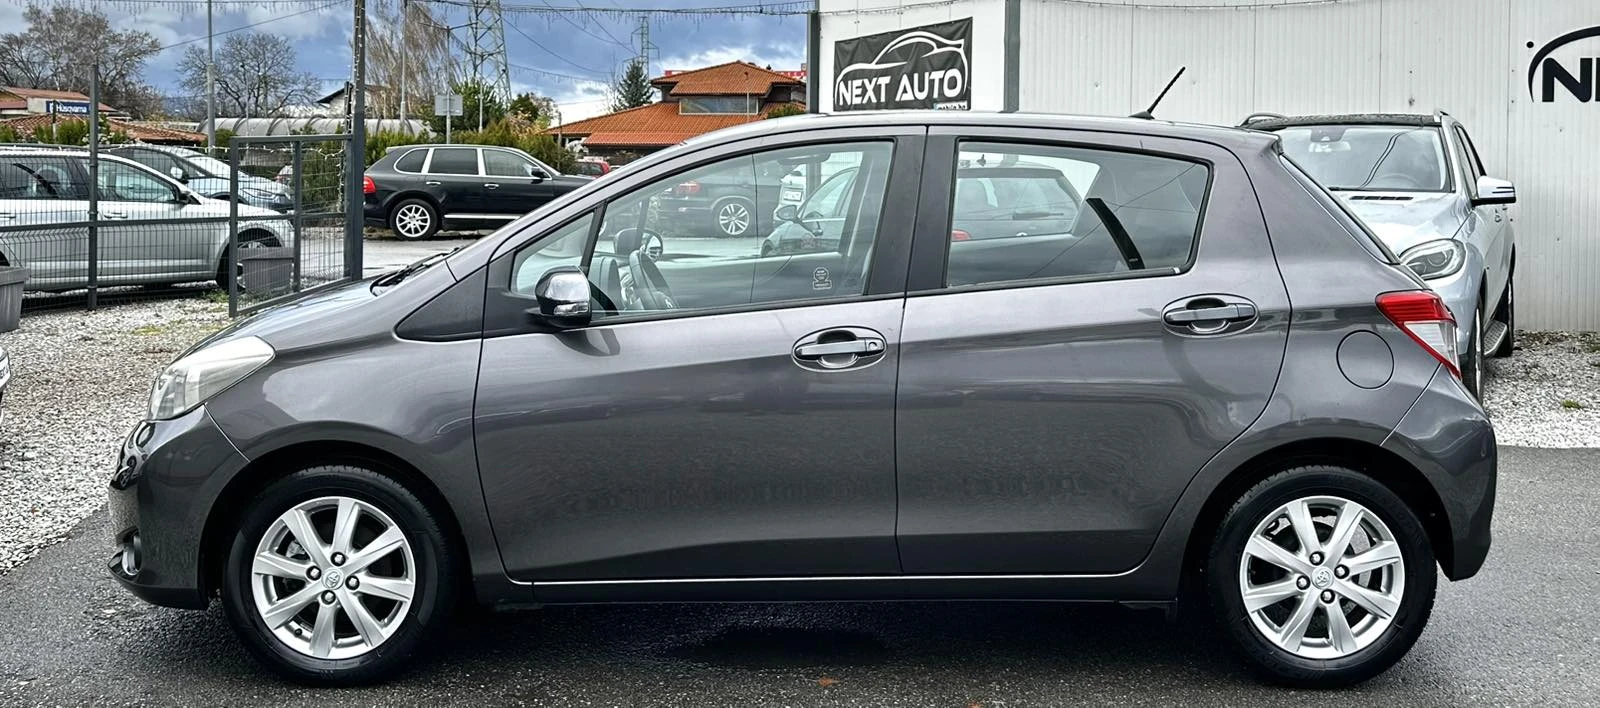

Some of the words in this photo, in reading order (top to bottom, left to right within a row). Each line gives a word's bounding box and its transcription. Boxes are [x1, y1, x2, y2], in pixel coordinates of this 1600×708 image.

[839, 76, 891, 106] NEXT
[895, 68, 963, 101] AUTO
[1542, 57, 1600, 103] N
